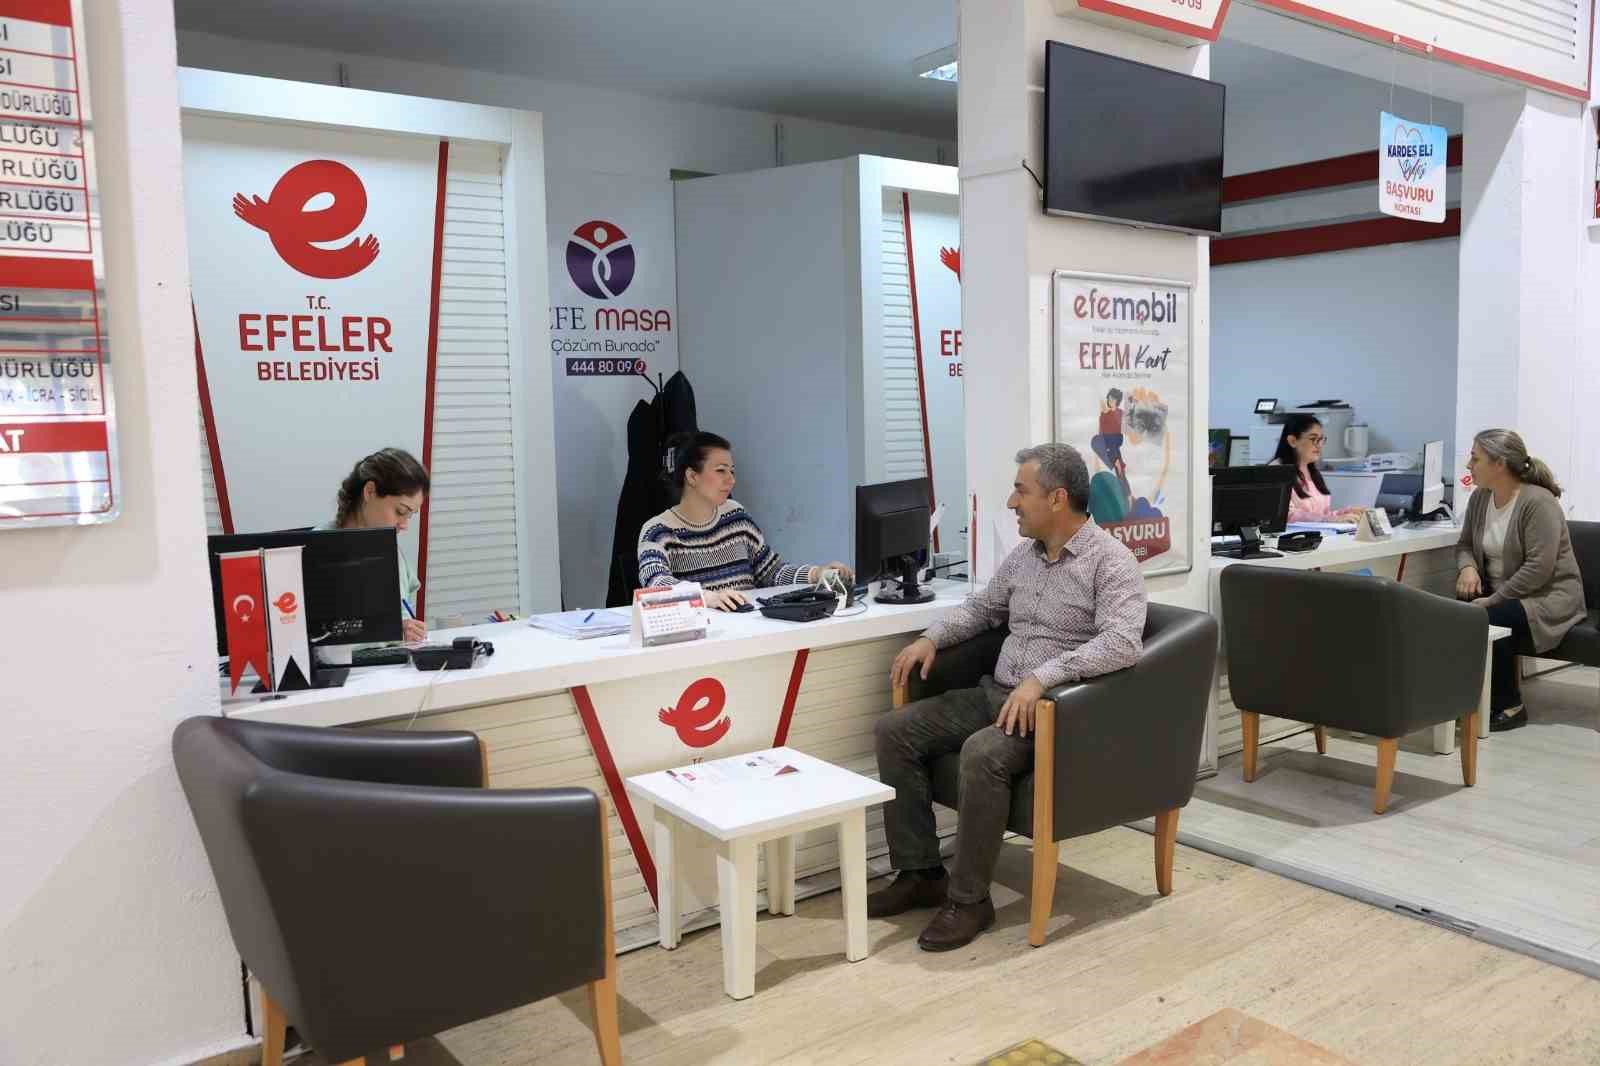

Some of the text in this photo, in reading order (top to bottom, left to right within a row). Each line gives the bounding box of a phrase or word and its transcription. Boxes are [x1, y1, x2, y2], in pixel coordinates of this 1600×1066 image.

[306, 296, 331, 311] T.C.
[549, 306, 671, 332] FE MASA
[238, 314, 393, 353] EFELER
[257, 356, 380, 382] BELEDİYESİ
[571, 360, 633, 374] 444 80 09
[1079, 342, 1173, 371] EFEM Kart
